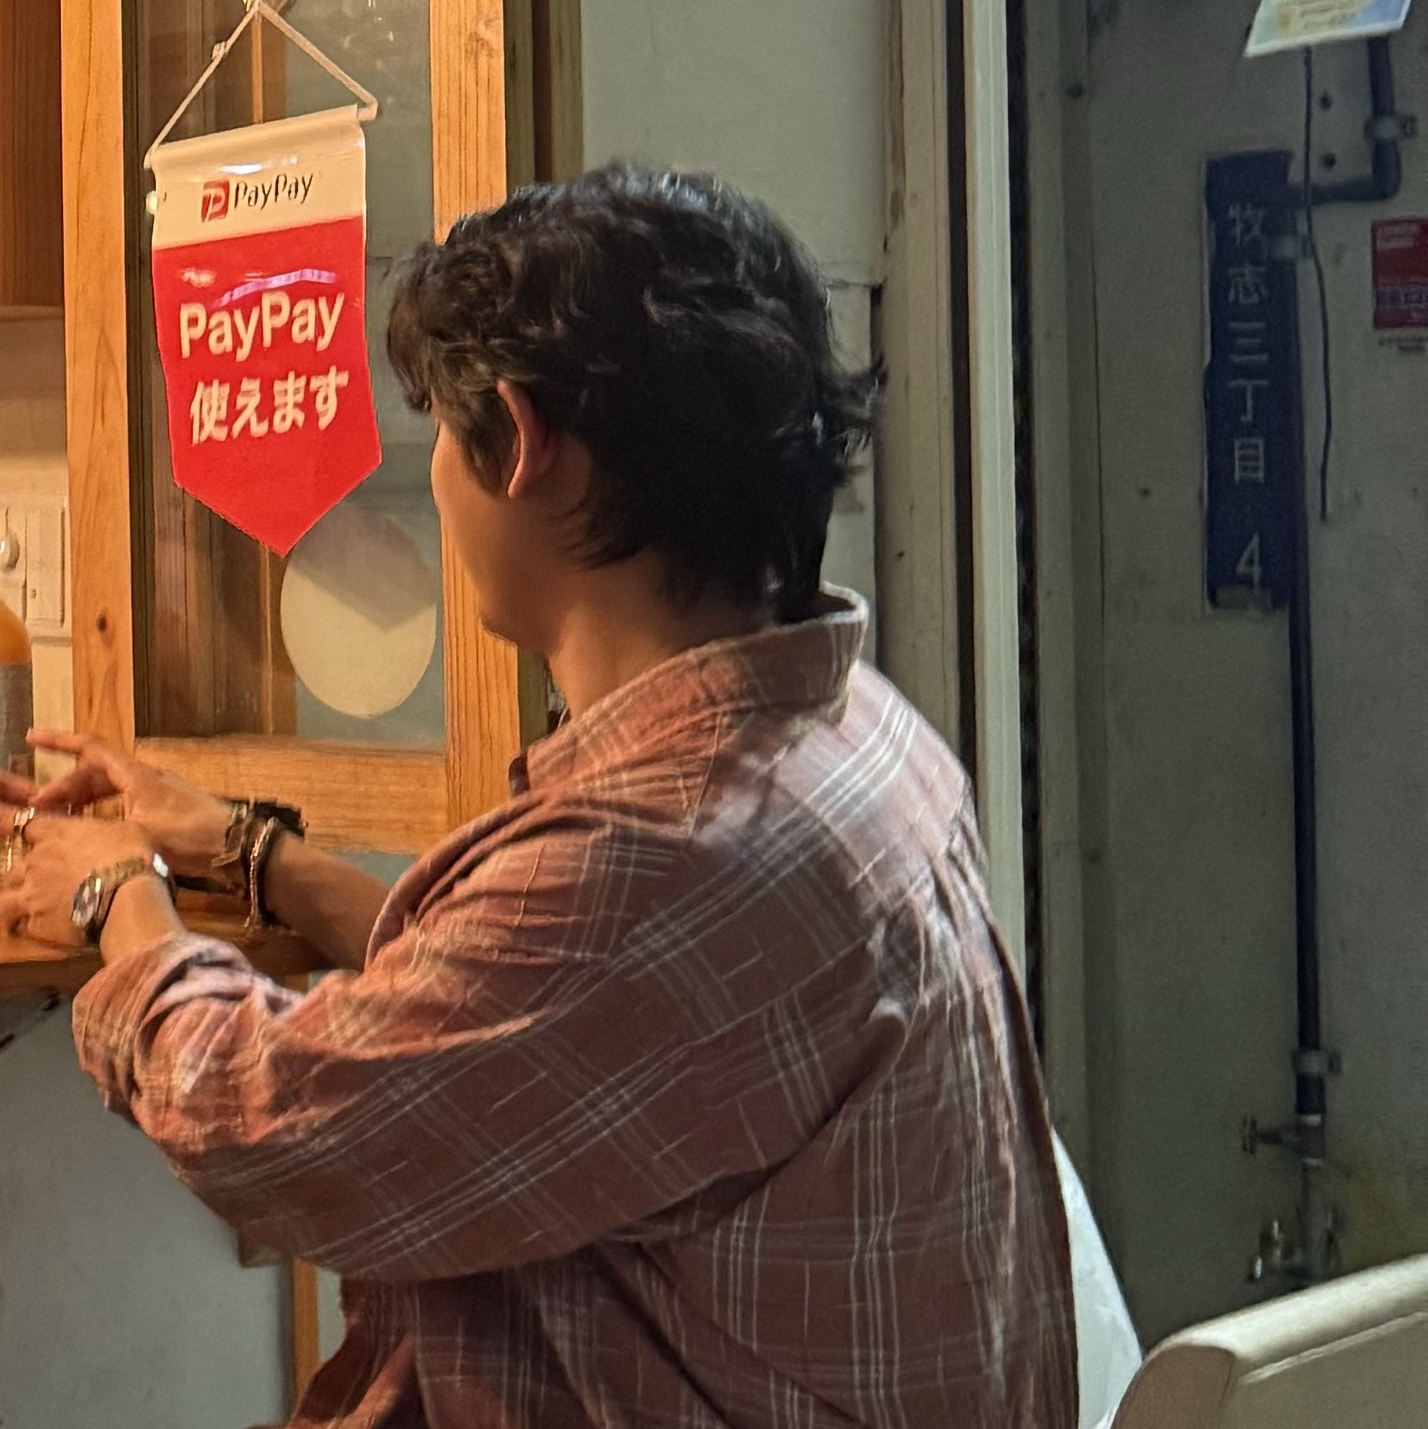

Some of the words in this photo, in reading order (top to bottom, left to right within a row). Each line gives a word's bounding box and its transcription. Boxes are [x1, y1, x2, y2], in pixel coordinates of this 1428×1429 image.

[233, 172, 314, 210] PayPay
[179, 290, 346, 363] PayPay
[1226, 202, 1270, 485] 牧志三丁目
[188, 365, 350, 446] 使えます
[1234, 530, 1262, 595] 4
